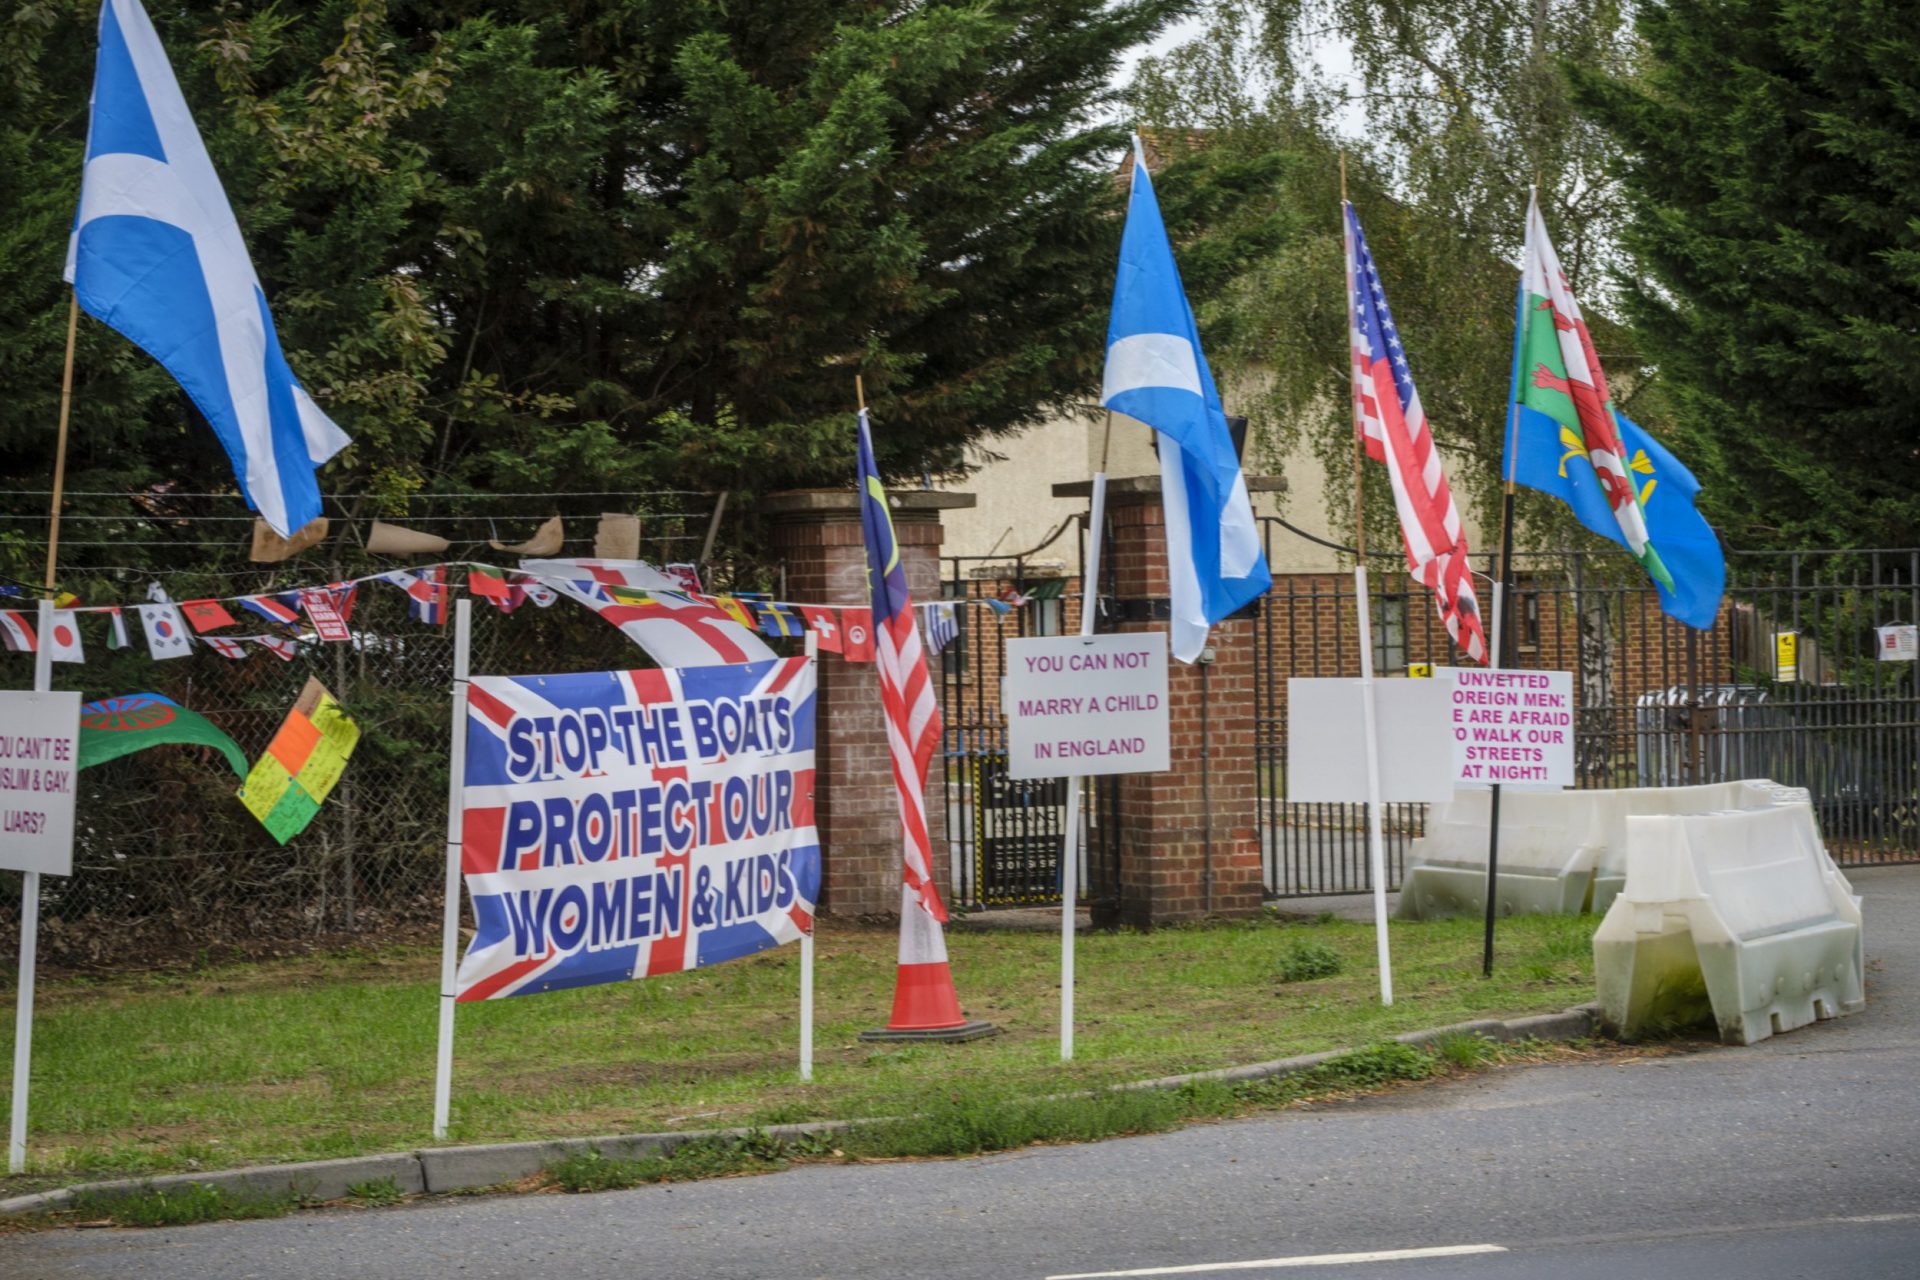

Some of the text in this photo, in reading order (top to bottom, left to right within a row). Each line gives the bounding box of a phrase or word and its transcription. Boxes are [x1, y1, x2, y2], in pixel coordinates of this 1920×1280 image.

[1025, 652, 1150, 673] YOU CAN NOT
[1458, 672, 1549, 689] UNVETTED
[1017, 694, 1158, 717] MARRY A CHILD
[1452, 690, 1565, 708] OREIGN MEN:
[1452, 708, 1570, 726] E ARE AFRAID
[507, 697, 791, 778] STOP THE BOATS
[1452, 727, 1564, 744] O WALK OUR
[0, 736, 70, 761] OU CAN'T BE
[1034, 737, 1145, 759] IN ENGLAND
[1466, 746, 1543, 761] STREETS
[0, 767, 70, 793] SLIM & GAY.
[1461, 764, 1548, 780] AT NIGHT!
[4, 809, 46, 834] LIARS?
[502, 770, 792, 871] PROTECT OUR
[504, 849, 794, 956] WOMEN & KIDS
